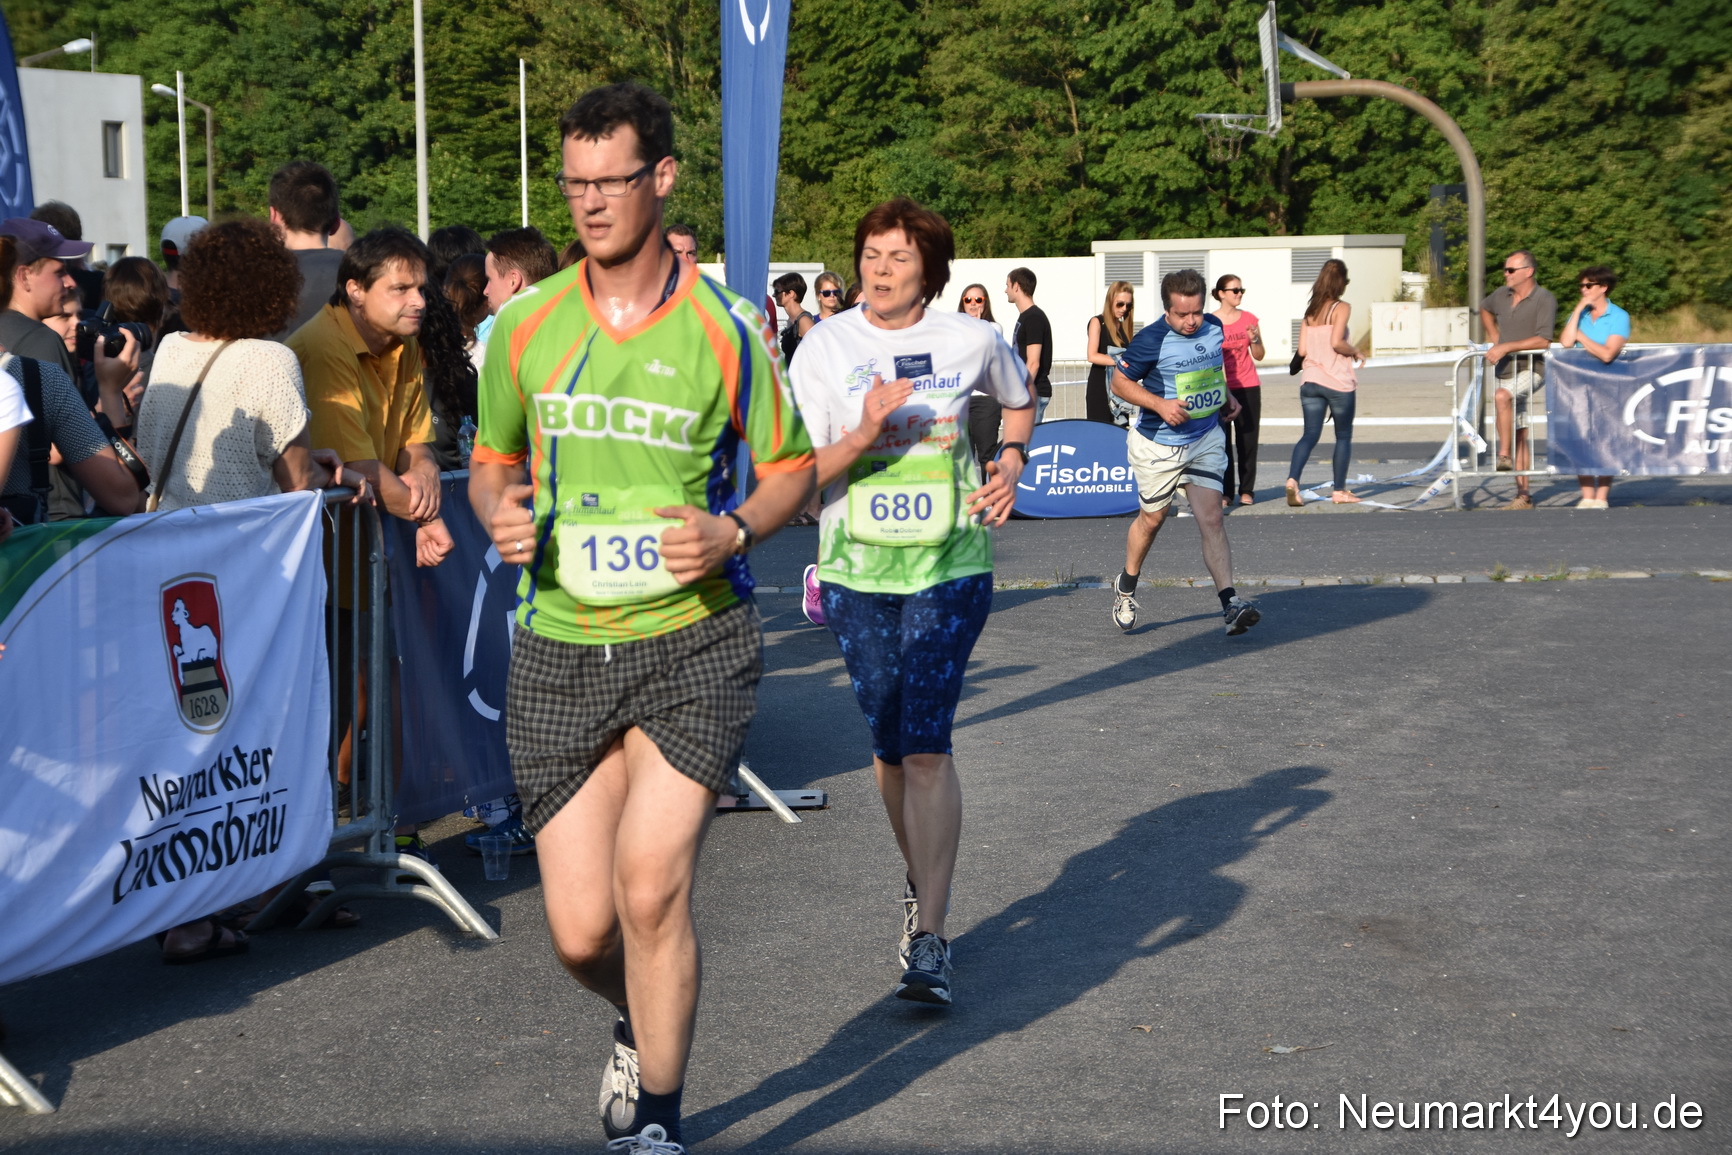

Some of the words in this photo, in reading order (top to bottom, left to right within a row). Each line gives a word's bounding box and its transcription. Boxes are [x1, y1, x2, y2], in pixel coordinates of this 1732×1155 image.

[1185, 389, 1222, 411] 6092
[533, 393, 701, 453] BOCK
[867, 434, 912, 451] aufen
[1046, 484, 1133, 496] AUTOMOBILE
[870, 492, 932, 521] 680
[581, 535, 659, 572] 136
[189, 694, 220, 719] 1628
